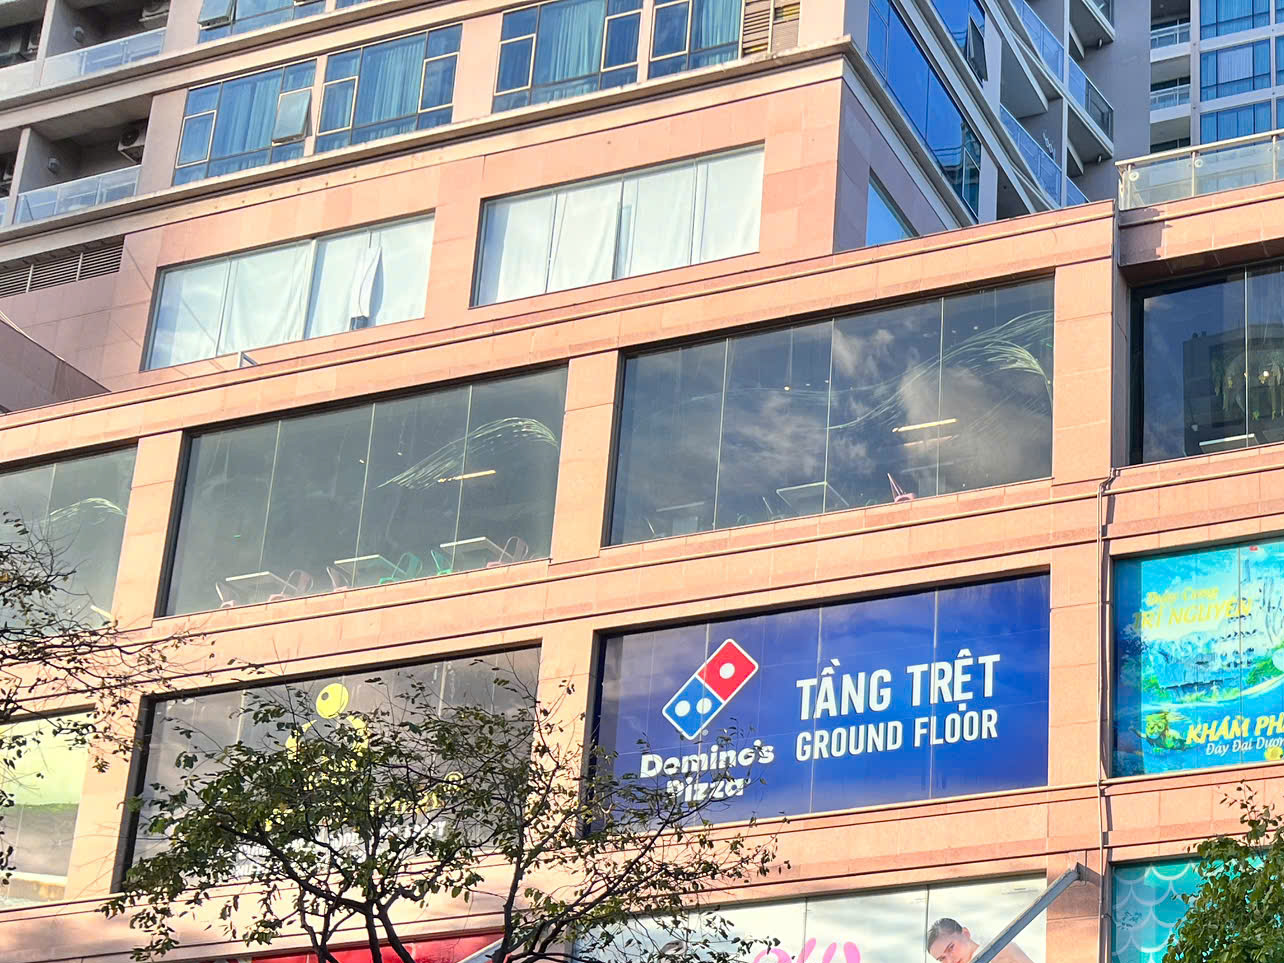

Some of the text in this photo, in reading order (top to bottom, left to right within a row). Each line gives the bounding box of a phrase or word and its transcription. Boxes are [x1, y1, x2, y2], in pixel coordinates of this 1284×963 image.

[796, 649, 1000, 720] TẦNG TRỆT
[796, 709, 998, 761] GROUND FLOOR
[1186, 715, 1250, 745] KHÁM
[639, 739, 775, 780] Domino's
